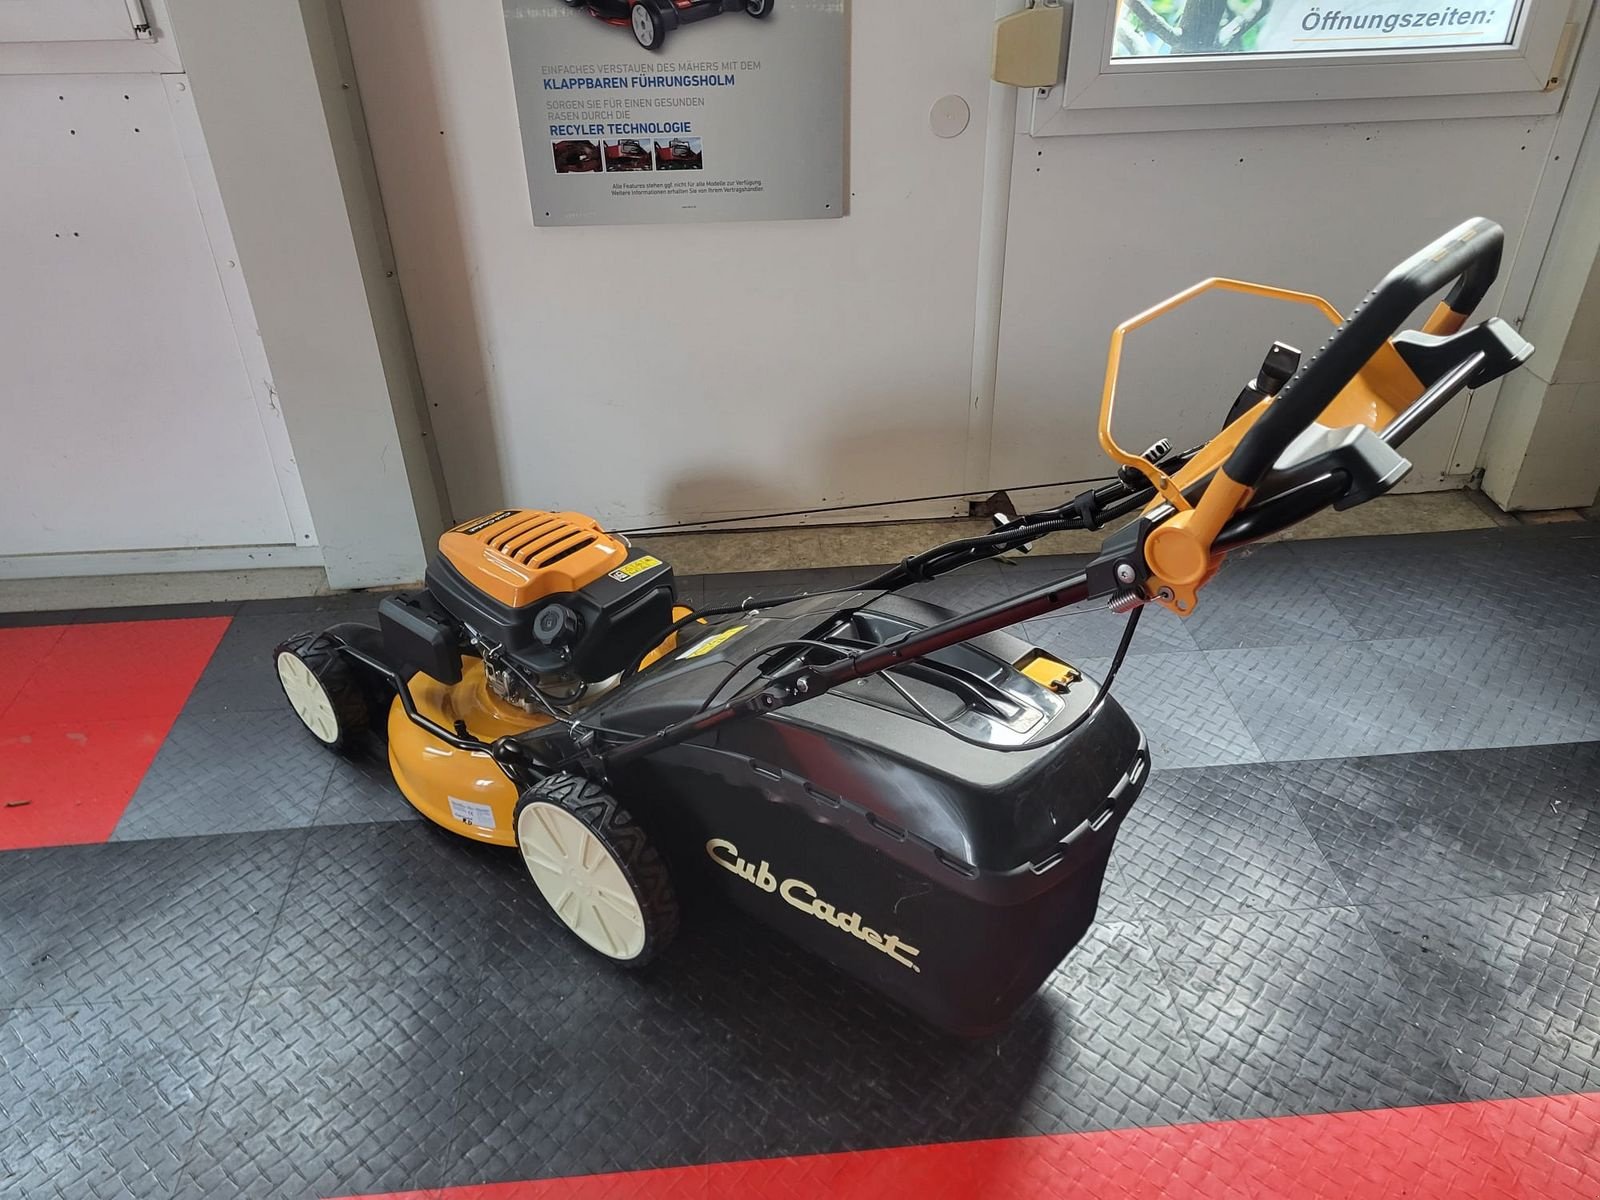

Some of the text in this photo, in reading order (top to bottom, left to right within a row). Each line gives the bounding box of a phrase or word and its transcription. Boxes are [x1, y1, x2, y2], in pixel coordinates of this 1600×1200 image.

[1301, 7, 1496, 33] Öffnungszeiten:
[541, 60, 761, 75] EINFACHES VERSTAUEN DES MÄHERS MIT DEM
[543, 73, 735, 90] KLAPPBAREN FÜHRUNGSHOLM
[546, 97, 705, 110] SORGEN SIE FÜR EINEN GESUNDEN
[547, 110, 631, 121] RASEN DURCH DIE
[549, 122, 692, 136] RECYLER TECHNOLOGIE
[705, 838, 920, 972] Cub Cadet
